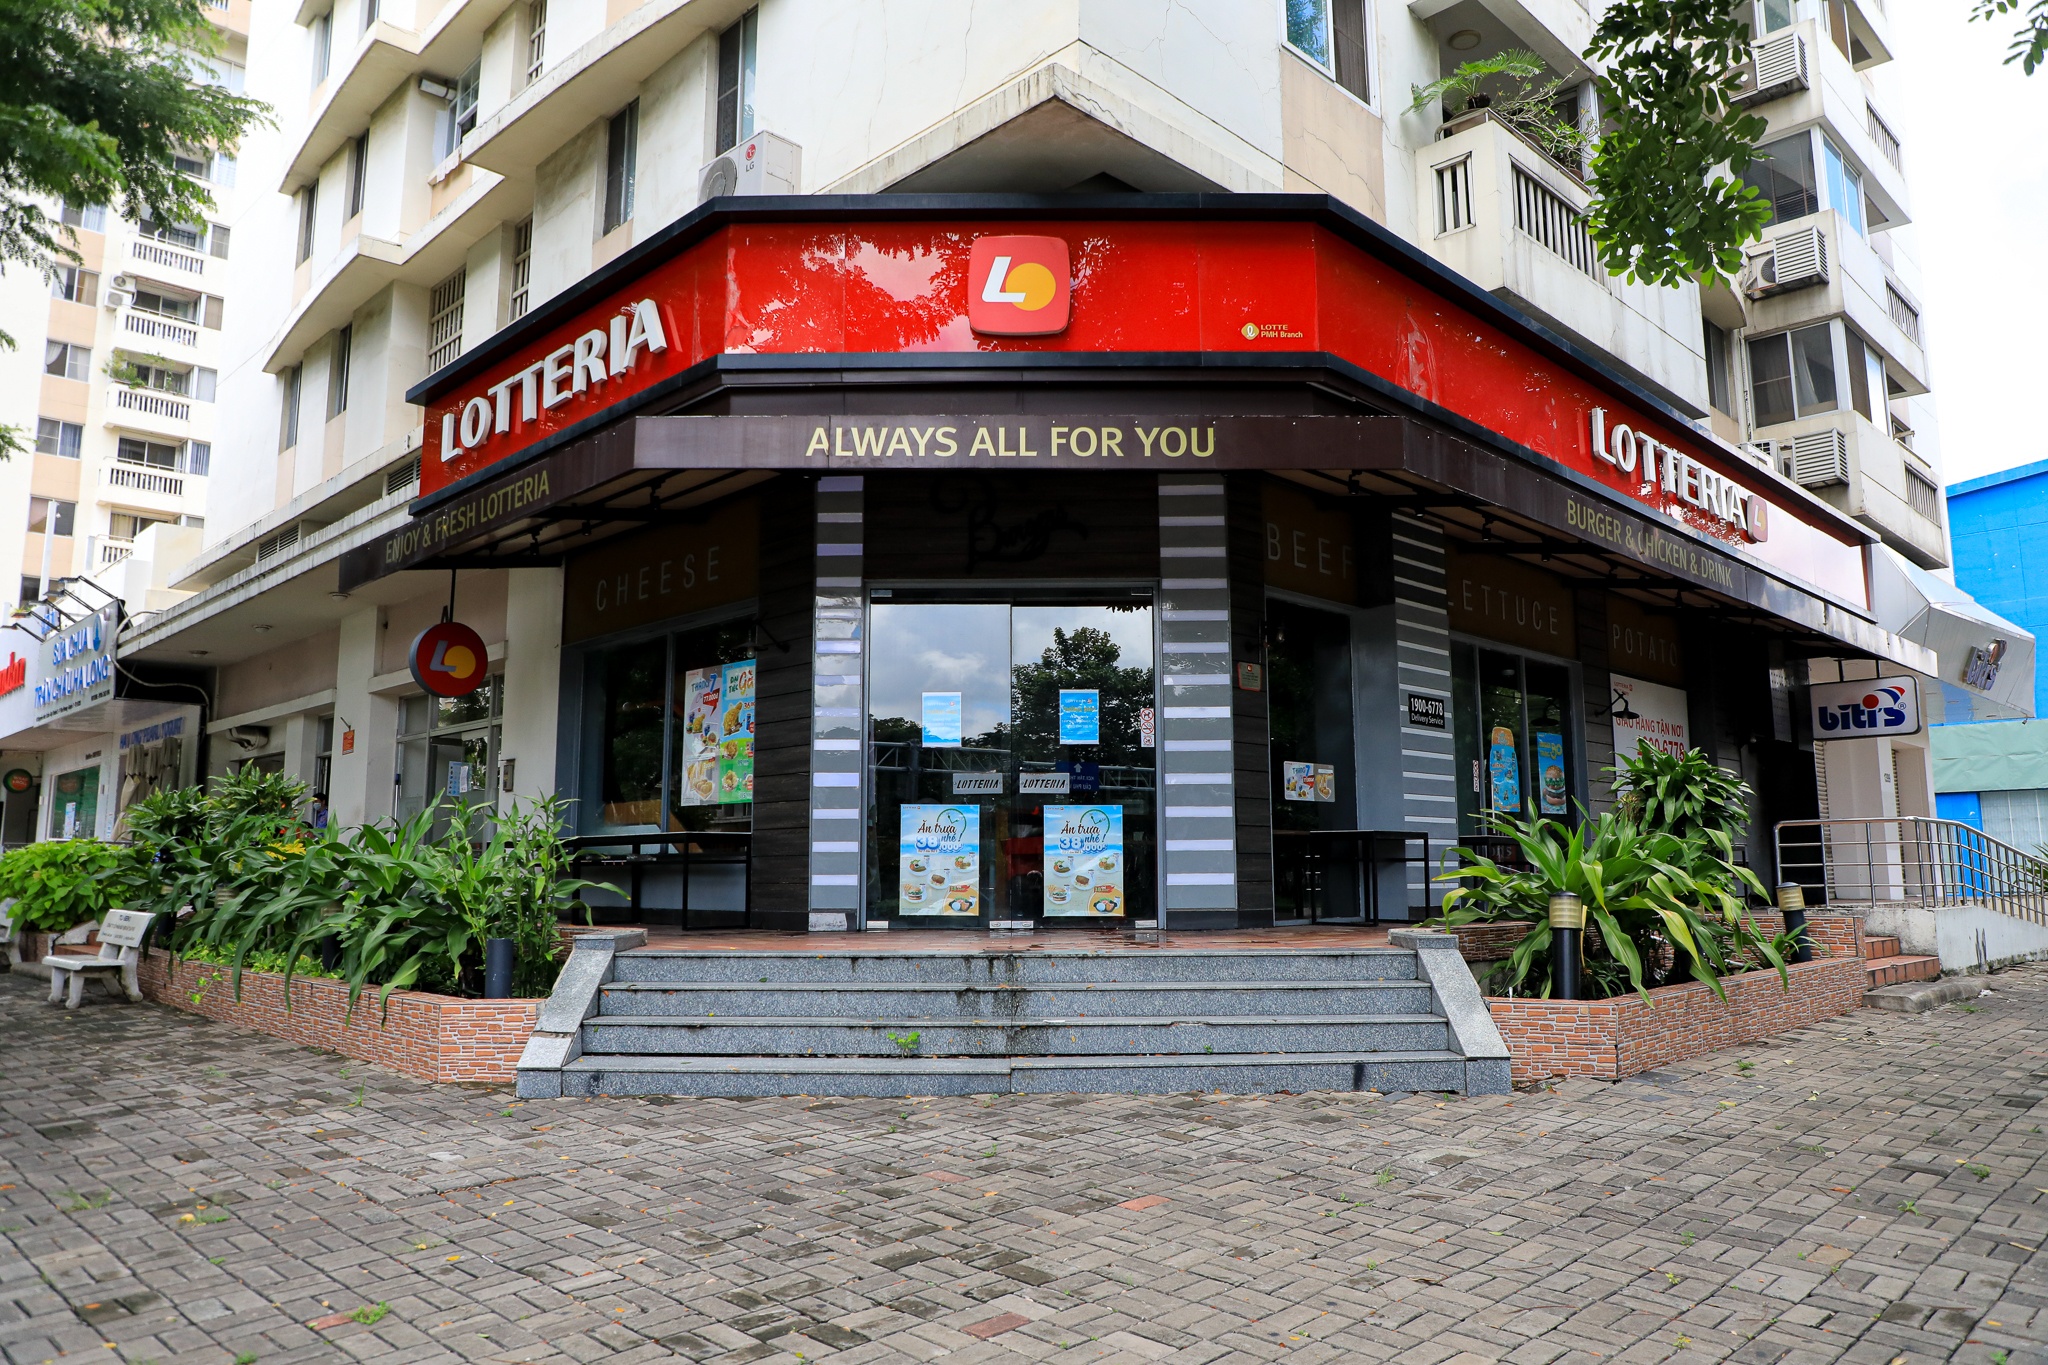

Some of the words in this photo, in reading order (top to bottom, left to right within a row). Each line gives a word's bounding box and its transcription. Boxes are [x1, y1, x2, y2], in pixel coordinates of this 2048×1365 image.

[745, 161, 755, 172] LG
[441, 298, 667, 462] LOTTERIA
[805, 427, 958, 458] ALWAYS
[968, 427, 1037, 457] ALL
[1051, 427, 1125, 458] FOR
[1135, 427, 1216, 458] YOU
[1591, 407, 1748, 531] LOTTERIA
[385, 523, 421, 565] ENJOY
[422, 523, 432, 549] &
[435, 501, 476, 543] FRESH
[480, 469, 550, 524] LOTTERIA
[1267, 521, 1353, 579] BEEF
[1566, 499, 1622, 546] BURGER
[1625, 526, 1636, 549] &
[1637, 531, 1687, 571] CHICKEN
[1690, 552, 1699, 575] &
[1701, 556, 1733, 589] DRINK
[596, 545, 720, 612] CHEESE
[1448, 578, 1559, 635] ETTUCE
[1612, 623, 1678, 668] POTATO
[709, 673, 718, 693] 7
[1411, 697, 1443, 716] 1900-6778
[1411, 712, 1429, 725] Delivery
[1428, 715, 1444, 726] Service
[1636, 714, 1656, 733] HÀNG
[1656, 718, 1670, 738] TẬN
[1671, 723, 1684, 739] NƠI
[956, 780, 999, 789] LOTTERIA
[1023, 779, 1066, 789] LOTTERIA
[917, 820, 932, 834] Ăn
[1060, 821, 1076, 835] Ăn
